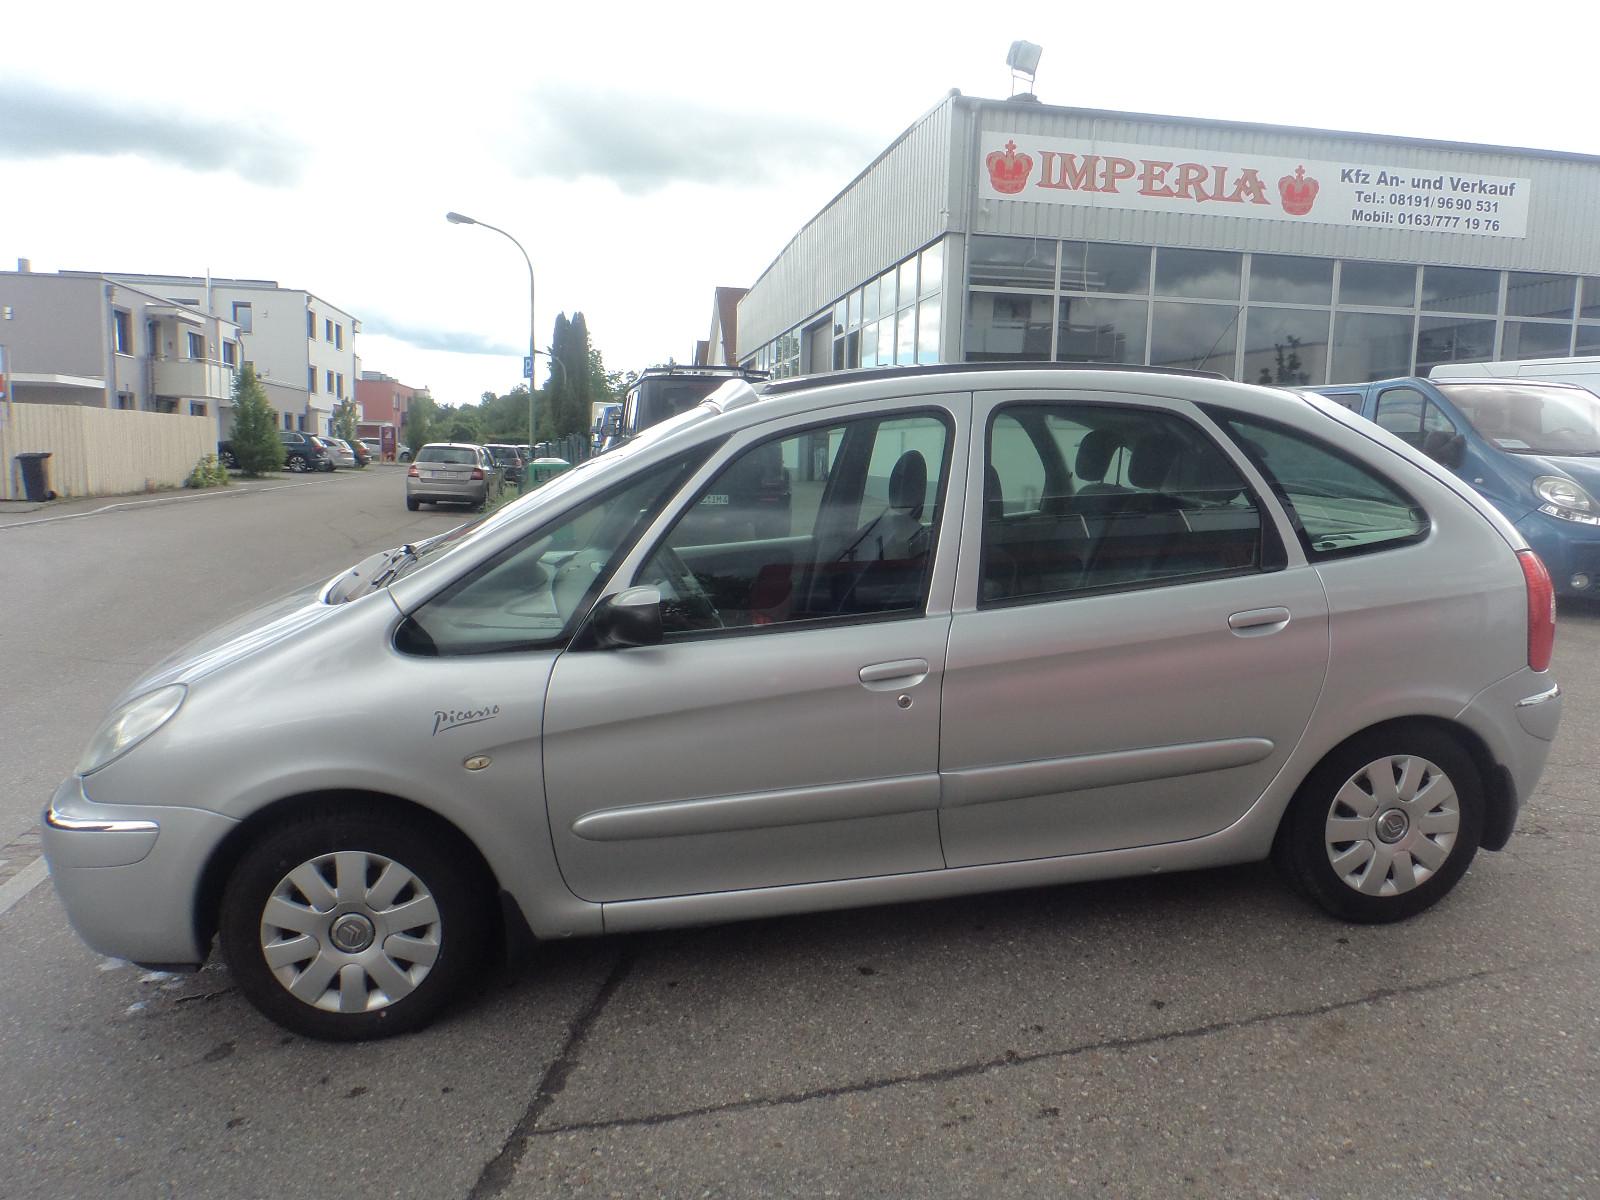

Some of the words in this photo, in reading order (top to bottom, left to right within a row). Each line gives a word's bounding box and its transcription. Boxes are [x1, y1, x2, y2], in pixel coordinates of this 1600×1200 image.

[1036, 150, 1271, 205] IMPERIA
[1340, 168, 1371, 185] Kfz
[1375, 170, 1406, 187] An-
[1411, 175, 1444, 191] und
[1449, 176, 1517, 197] Verkauf
[1355, 190, 1385, 204] Tel.:
[1475, 200, 1499, 214] 531
[1351, 209, 1394, 224] Mobil:
[1398, 212, 1461, 229] 0163/777
[1464, 217, 1481, 230] 19
[1483, 219, 1501, 232] 76
